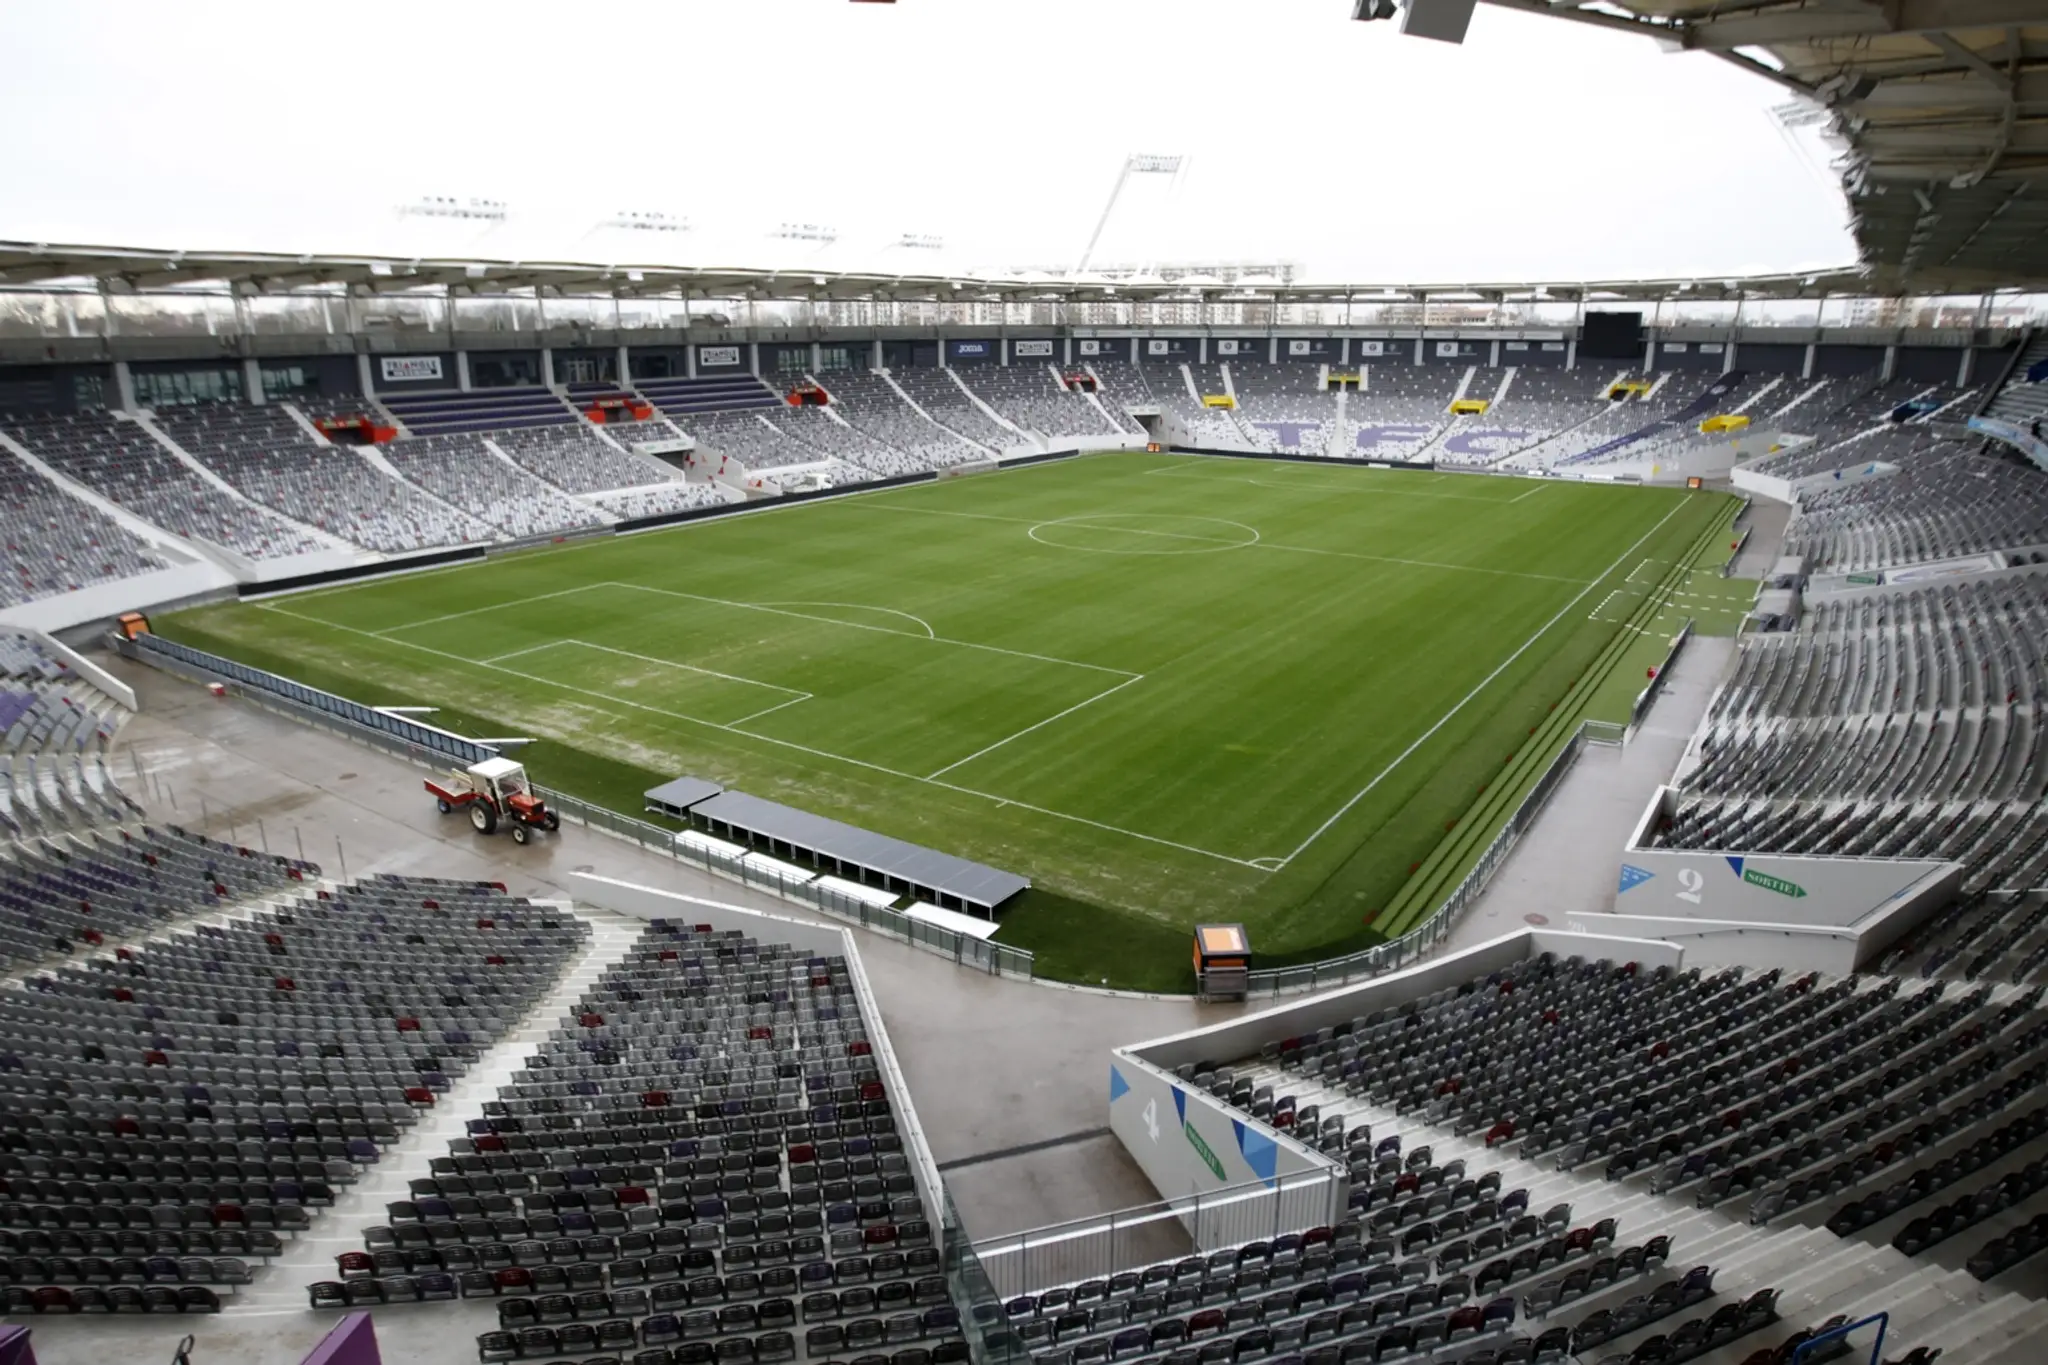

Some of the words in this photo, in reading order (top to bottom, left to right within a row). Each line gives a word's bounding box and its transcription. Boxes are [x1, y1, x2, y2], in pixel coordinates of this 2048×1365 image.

[1675, 868, 1704, 904] 2
[1748, 872, 1793, 894] SORTIE
[1142, 1097, 1160, 1147] 4
